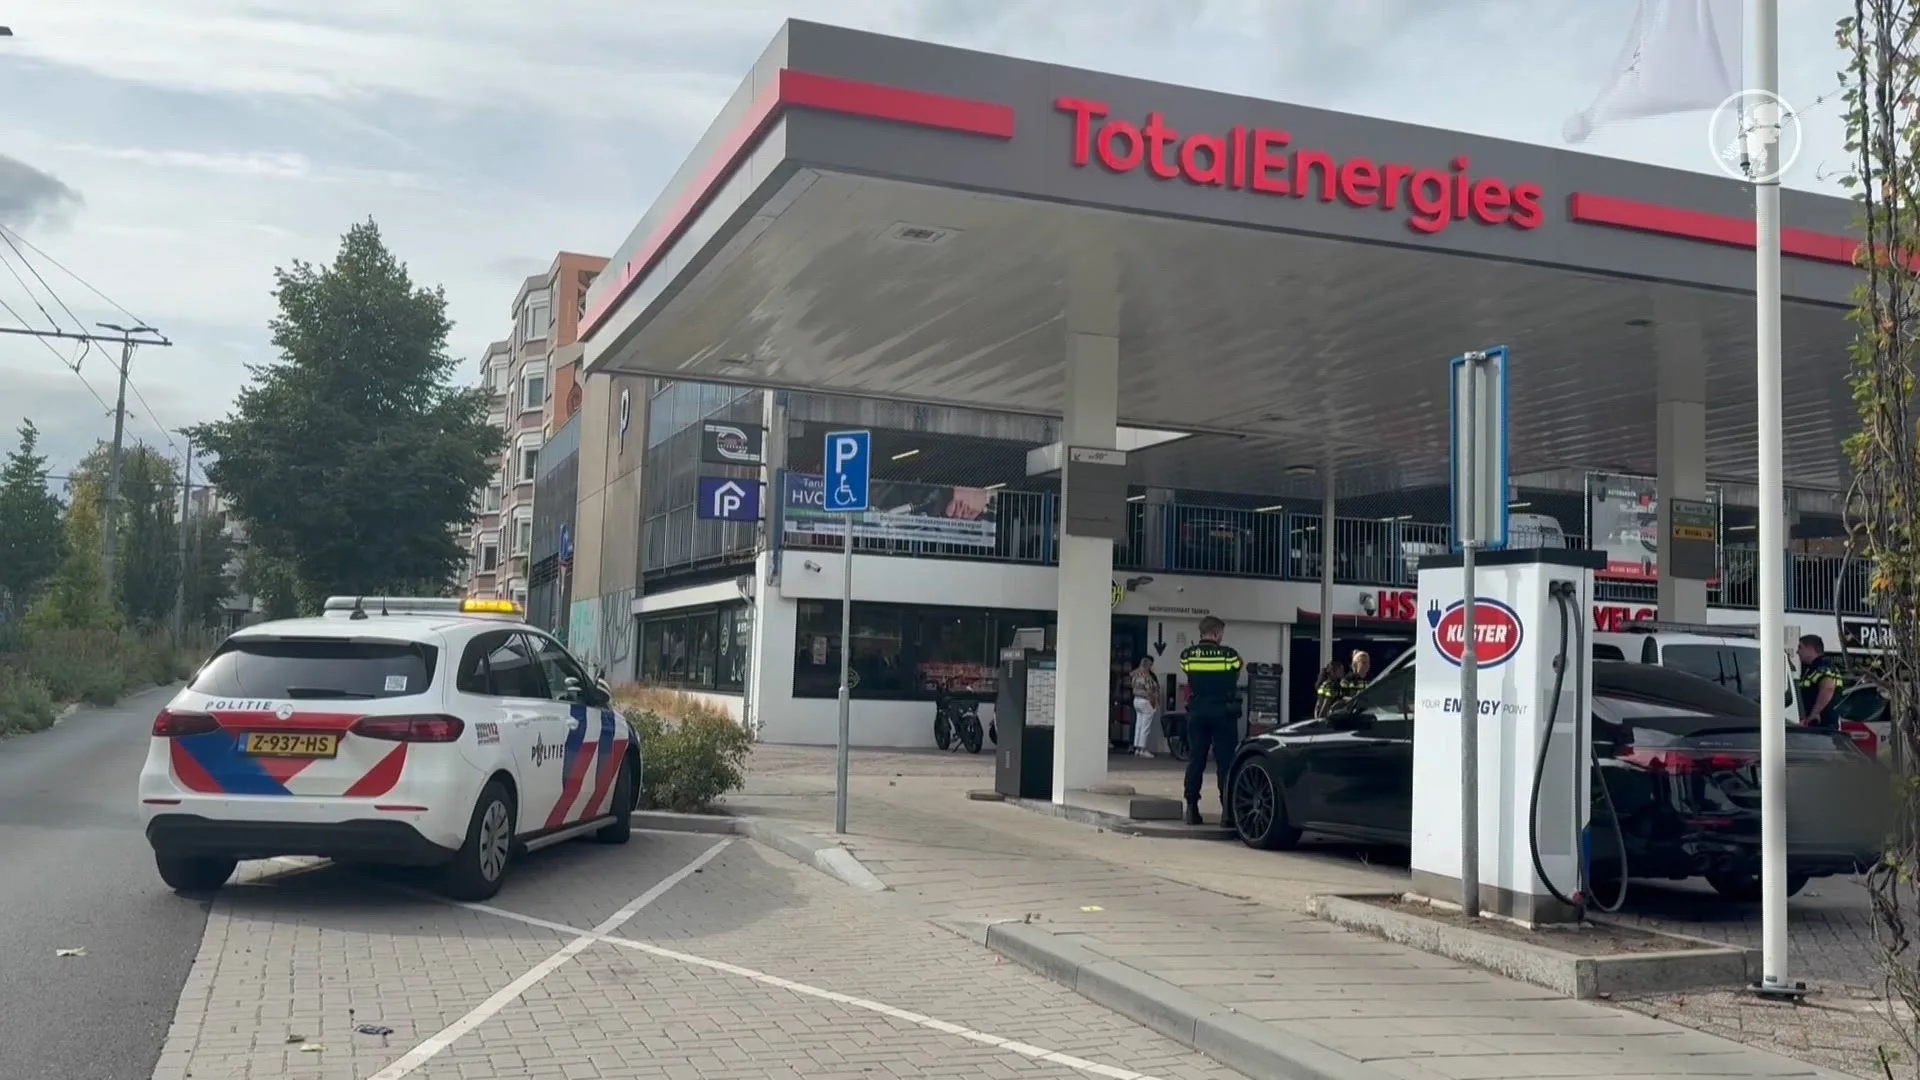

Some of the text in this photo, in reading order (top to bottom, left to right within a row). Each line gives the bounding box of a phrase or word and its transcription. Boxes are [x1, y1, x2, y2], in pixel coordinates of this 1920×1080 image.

[1055, 97, 1545, 233] TotalEnergies
[836, 438, 858, 474] P
[722, 495, 741, 517] P
[1378, 591, 1658, 633] HS VELG
[1446, 624, 1507, 643] KUTER
[205, 699, 273, 711] POLITIE
[1420, 697, 1528, 716] YOUR ENGY POINT
[252, 735, 329, 752] Z-937-HS
[531, 736, 564, 766] POLITIE
